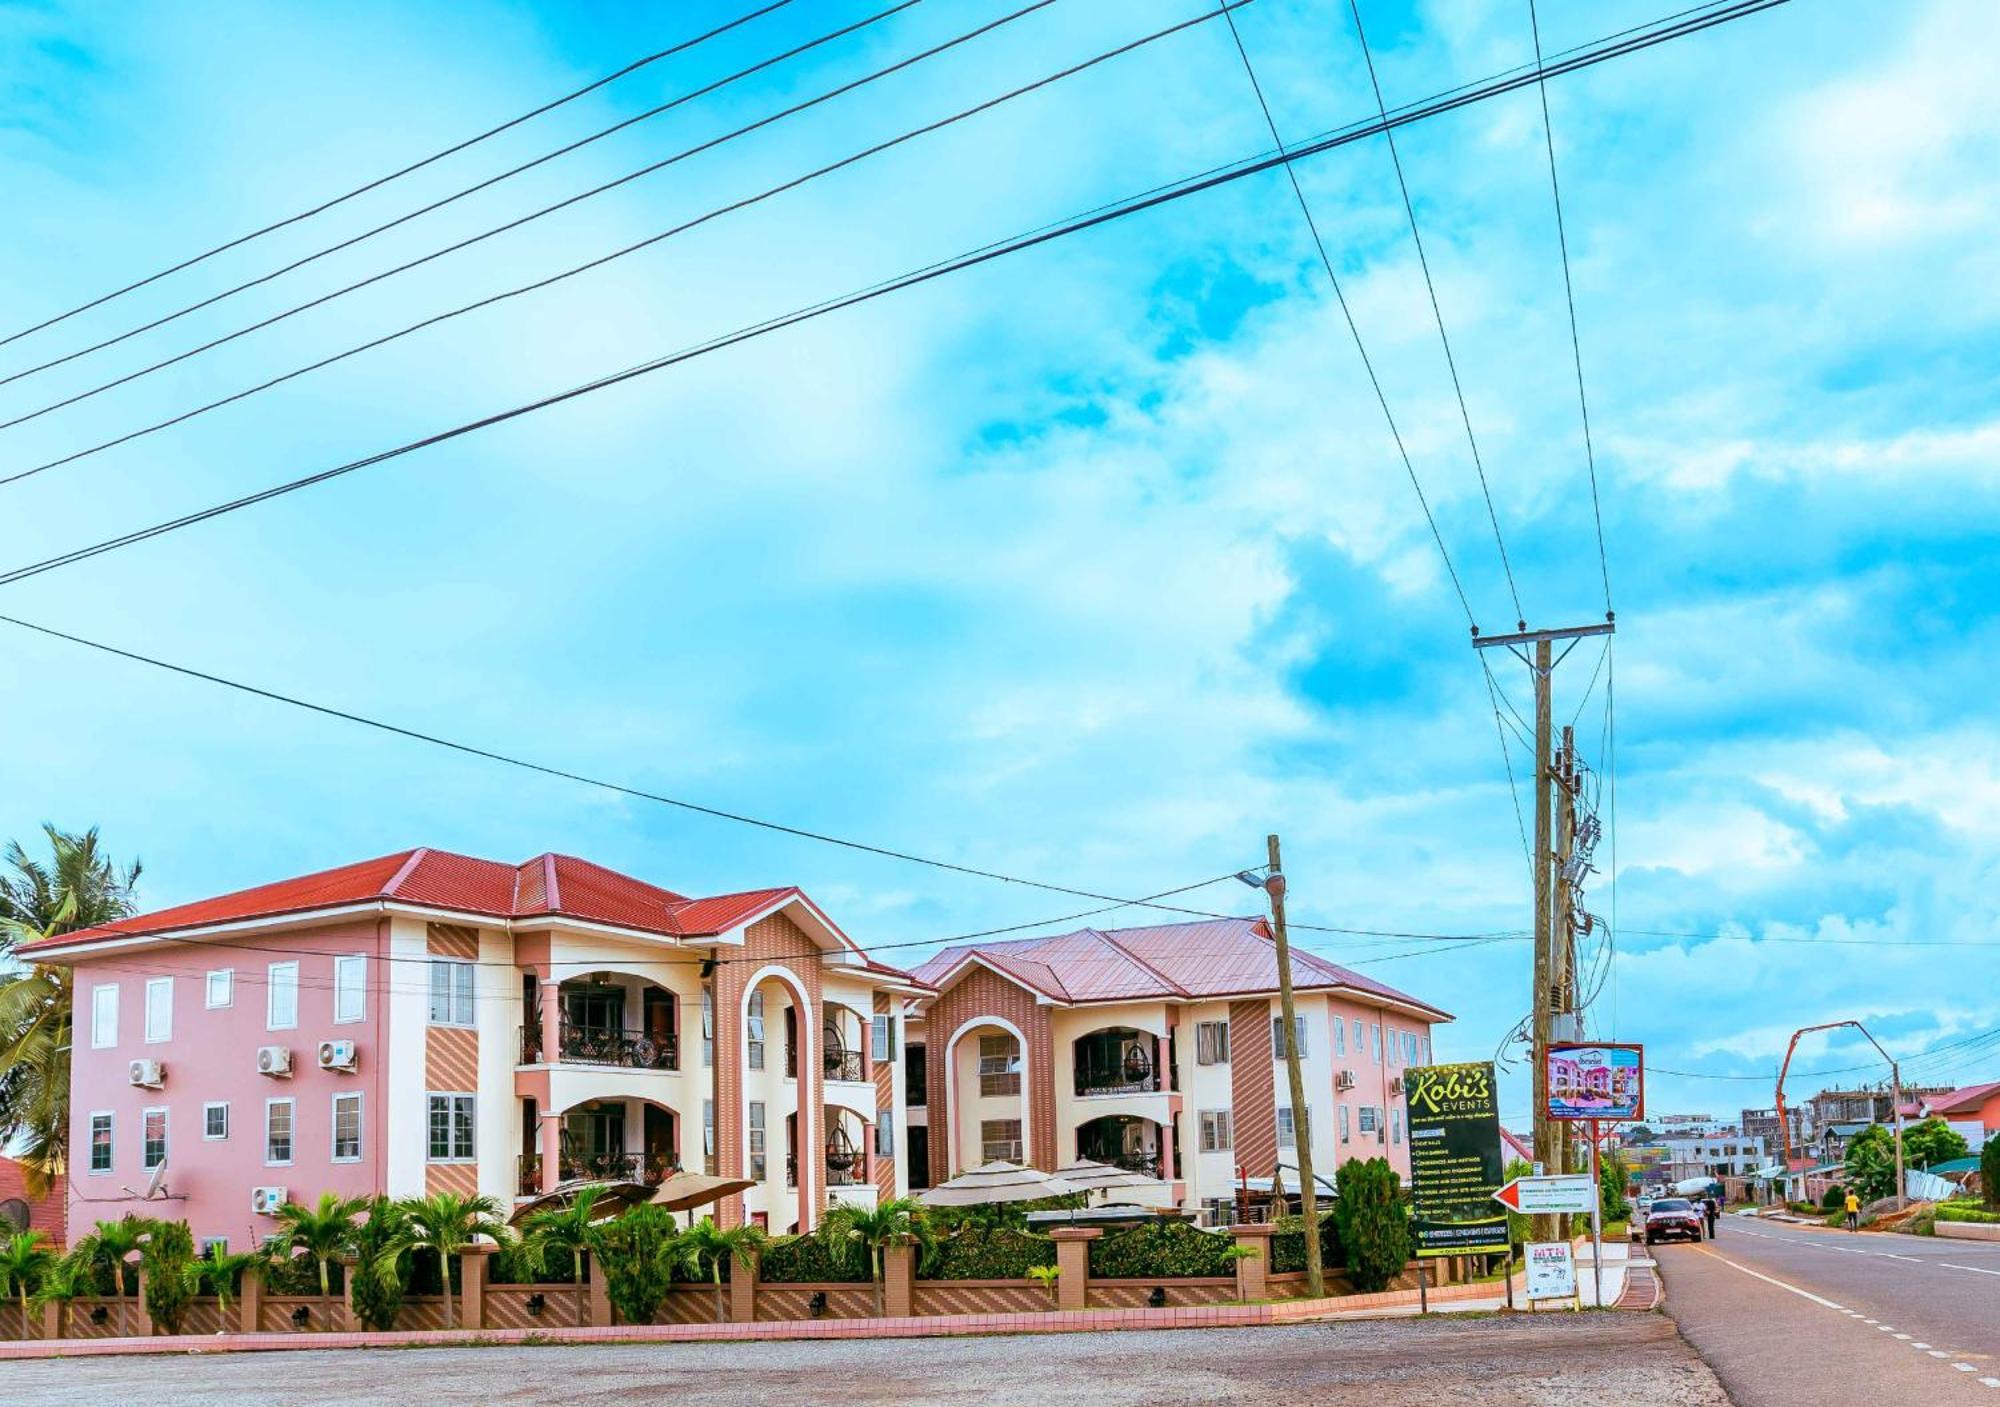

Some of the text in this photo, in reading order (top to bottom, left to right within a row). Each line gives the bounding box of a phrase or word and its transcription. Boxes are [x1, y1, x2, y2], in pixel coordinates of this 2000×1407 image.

[1410, 1072, 1489, 1113] Kobi's
[1442, 1100, 1490, 1112] EVENTS
[1534, 1247, 1565, 1257] MTN
